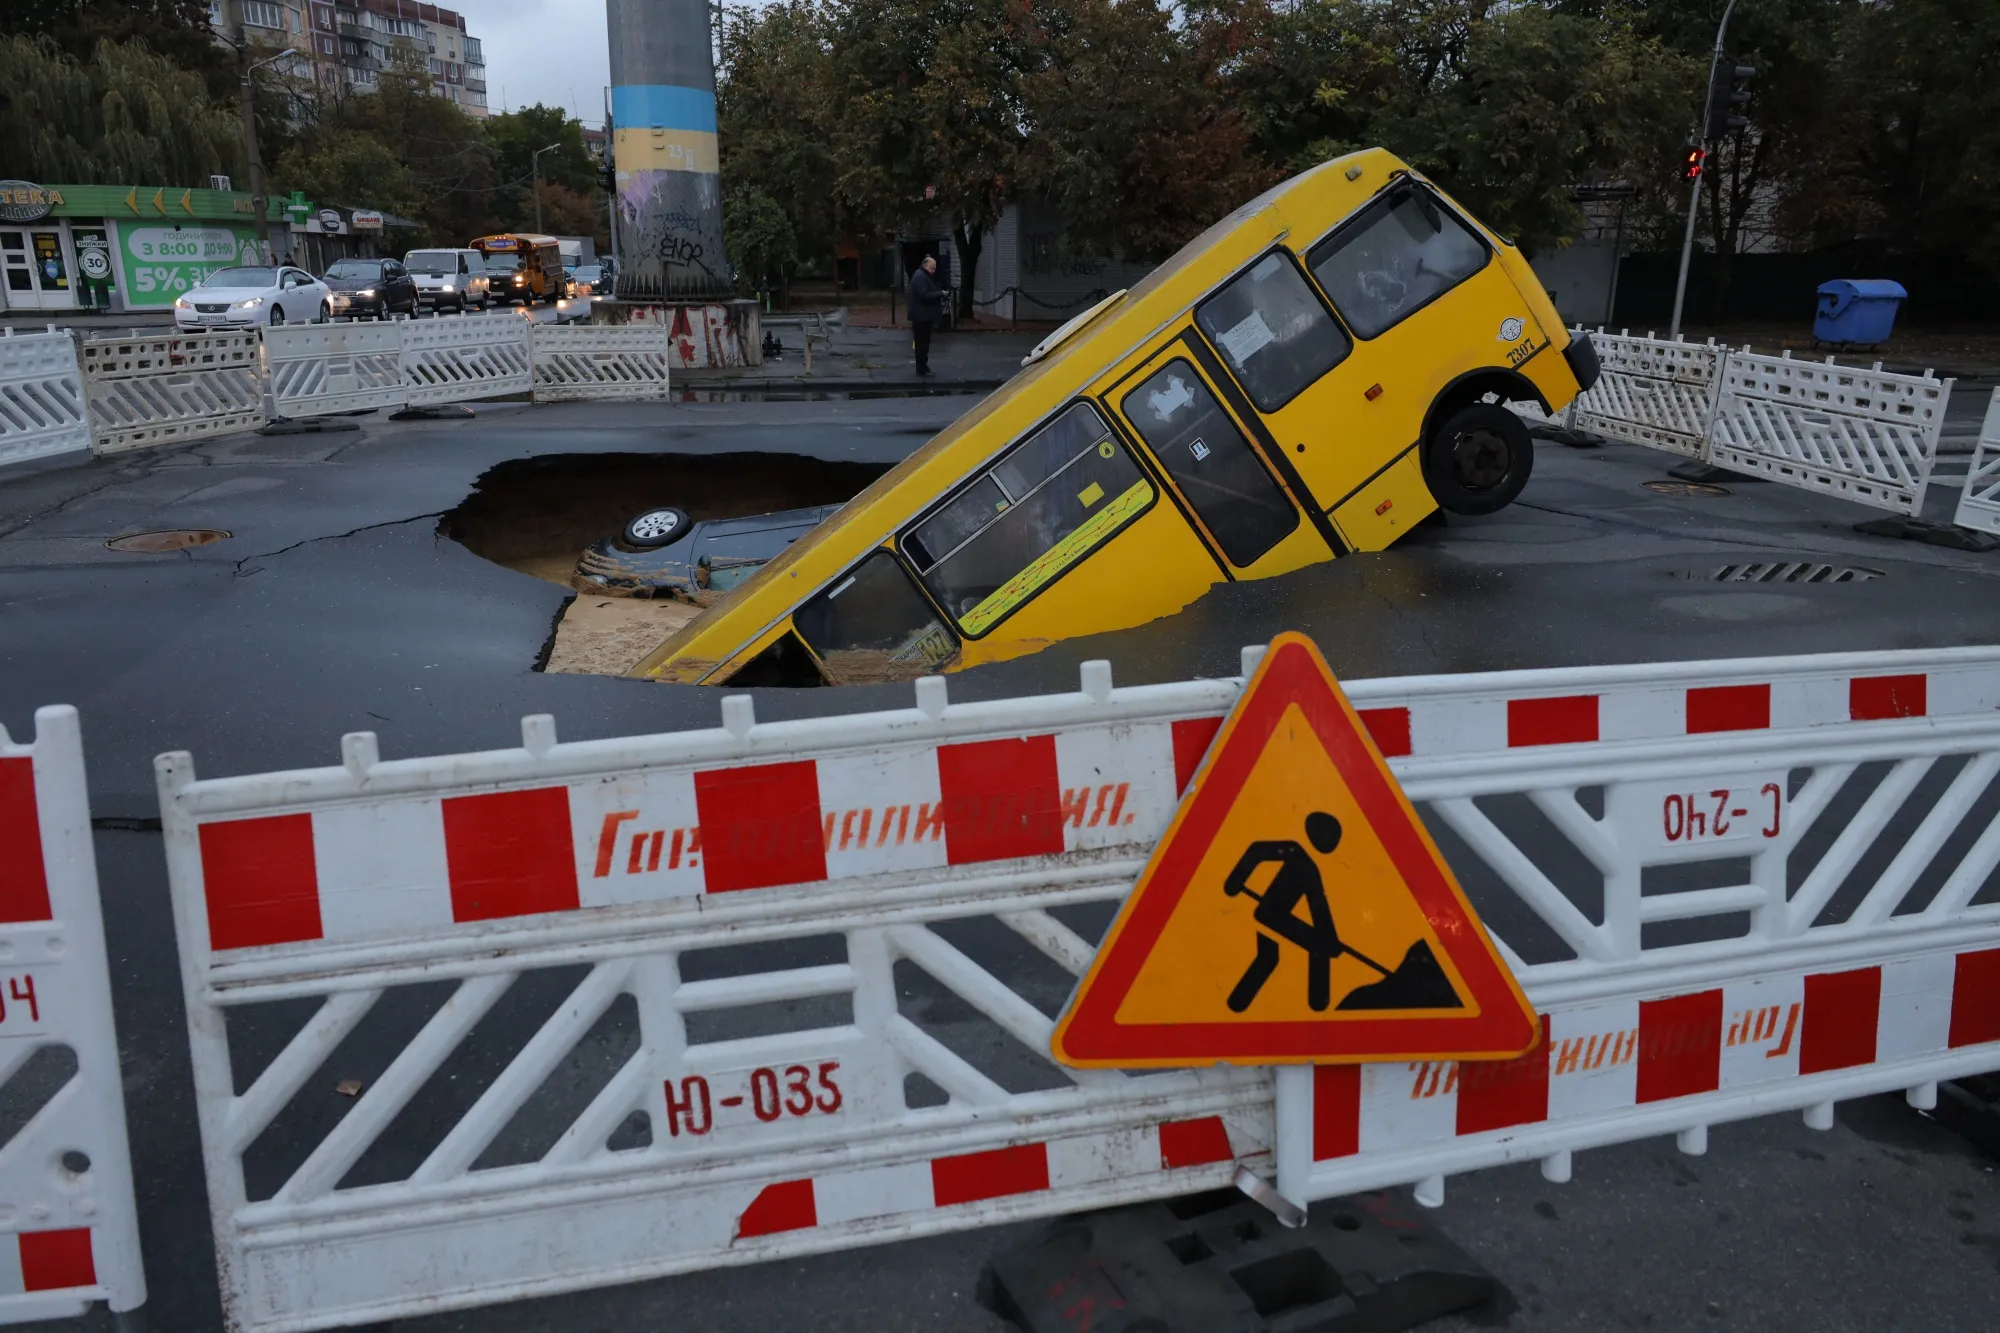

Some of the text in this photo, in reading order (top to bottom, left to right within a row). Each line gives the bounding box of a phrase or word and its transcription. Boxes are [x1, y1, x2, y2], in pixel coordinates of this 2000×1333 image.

[159, 243, 198, 255] 8:00
[203, 243, 216, 257] ДО
[135, 266, 187, 292] 5%
[1506, 338, 1534, 364] 7307
[0, 974, 39, 1024] 4
[664, 1062, 843, 1137] Ю-035
